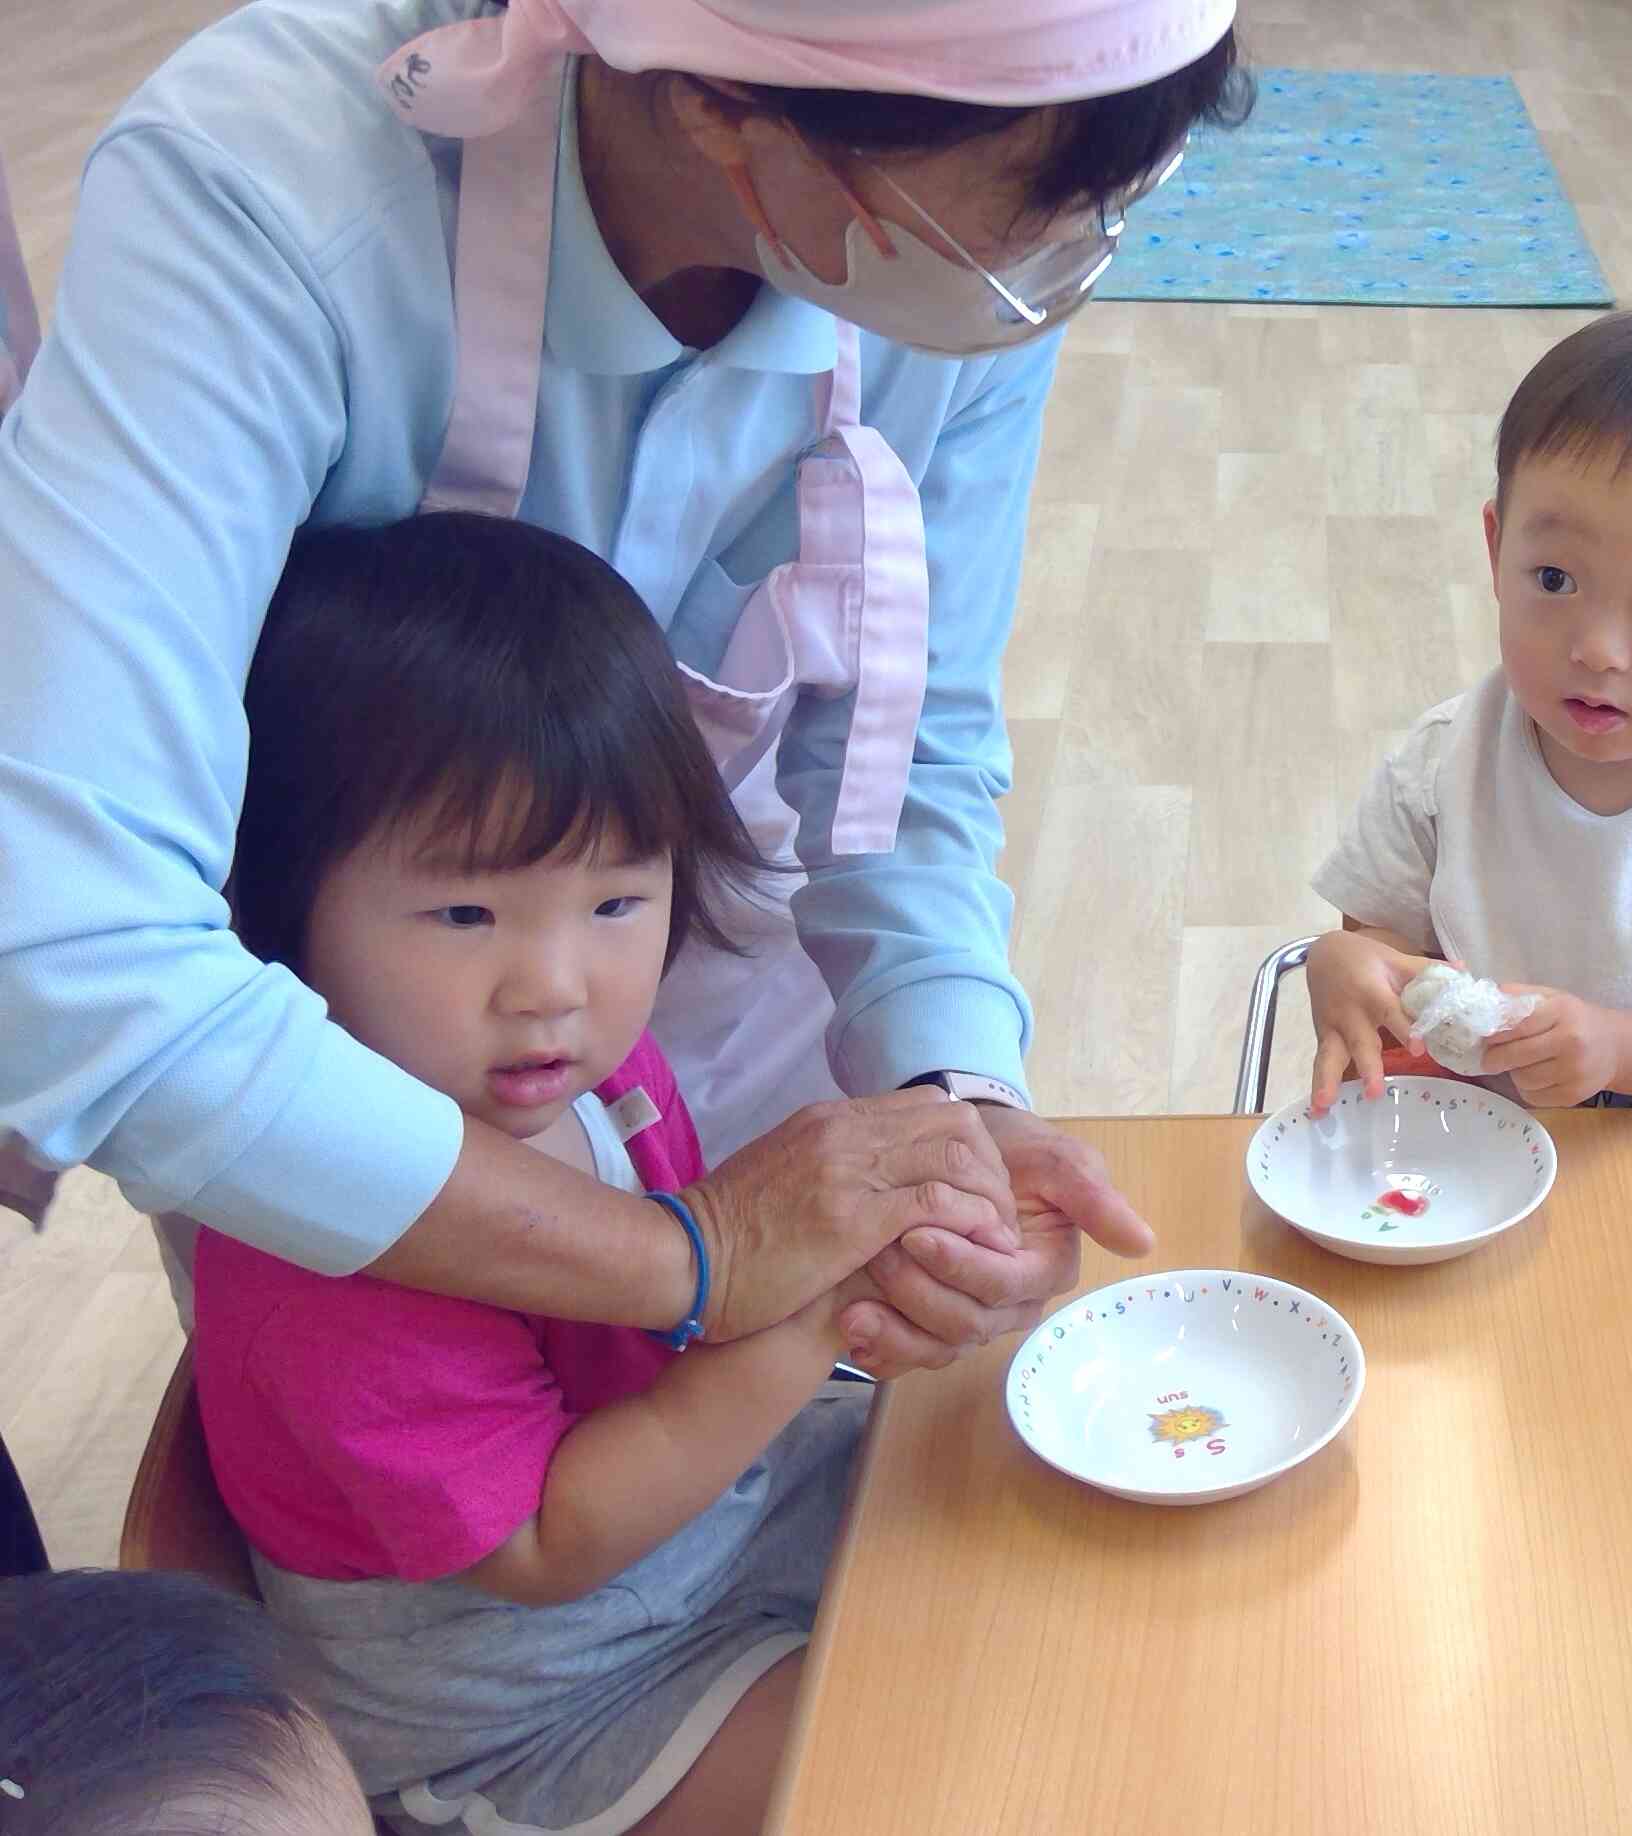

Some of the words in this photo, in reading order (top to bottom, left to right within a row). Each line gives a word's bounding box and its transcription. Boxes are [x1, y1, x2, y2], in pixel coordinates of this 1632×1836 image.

[1115, 1301, 1127, 1315] S
[1222, 1278, 1233, 1292] V
[1289, 1300, 1301, 1315] X
[1156, 1390, 1189, 1404] sun
[1206, 1438, 1227, 1456] S
